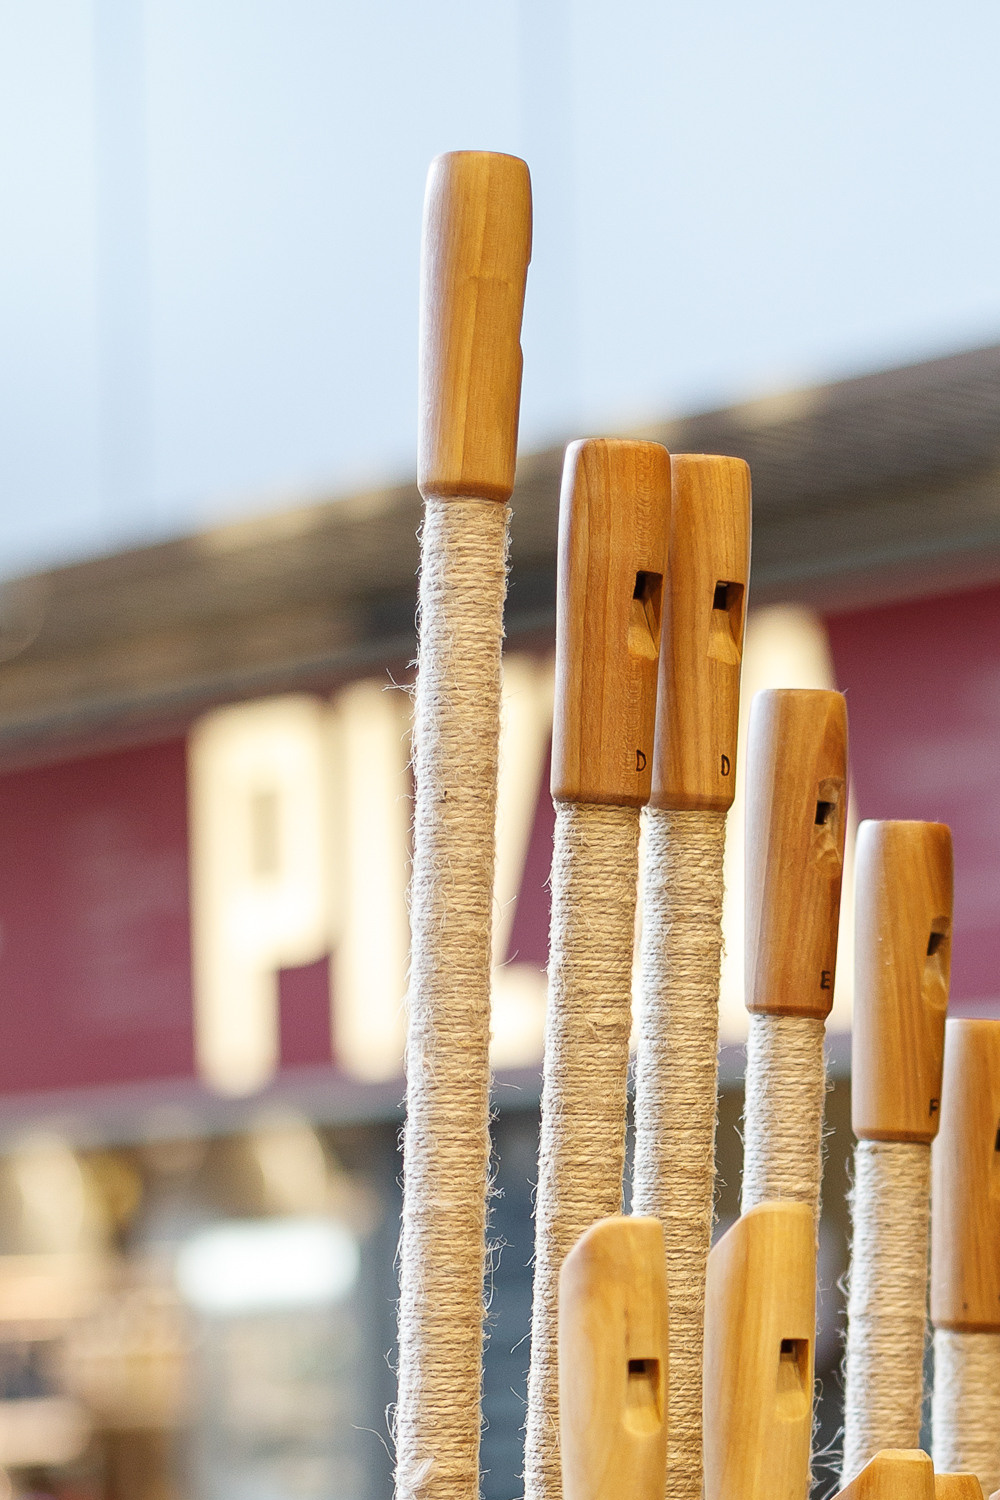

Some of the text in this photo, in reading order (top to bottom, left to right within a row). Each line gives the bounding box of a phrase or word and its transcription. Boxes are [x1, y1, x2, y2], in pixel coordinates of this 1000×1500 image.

[636, 749, 647, 772] D
[720, 754, 731, 777] D
[820, 970, 831, 990] E
